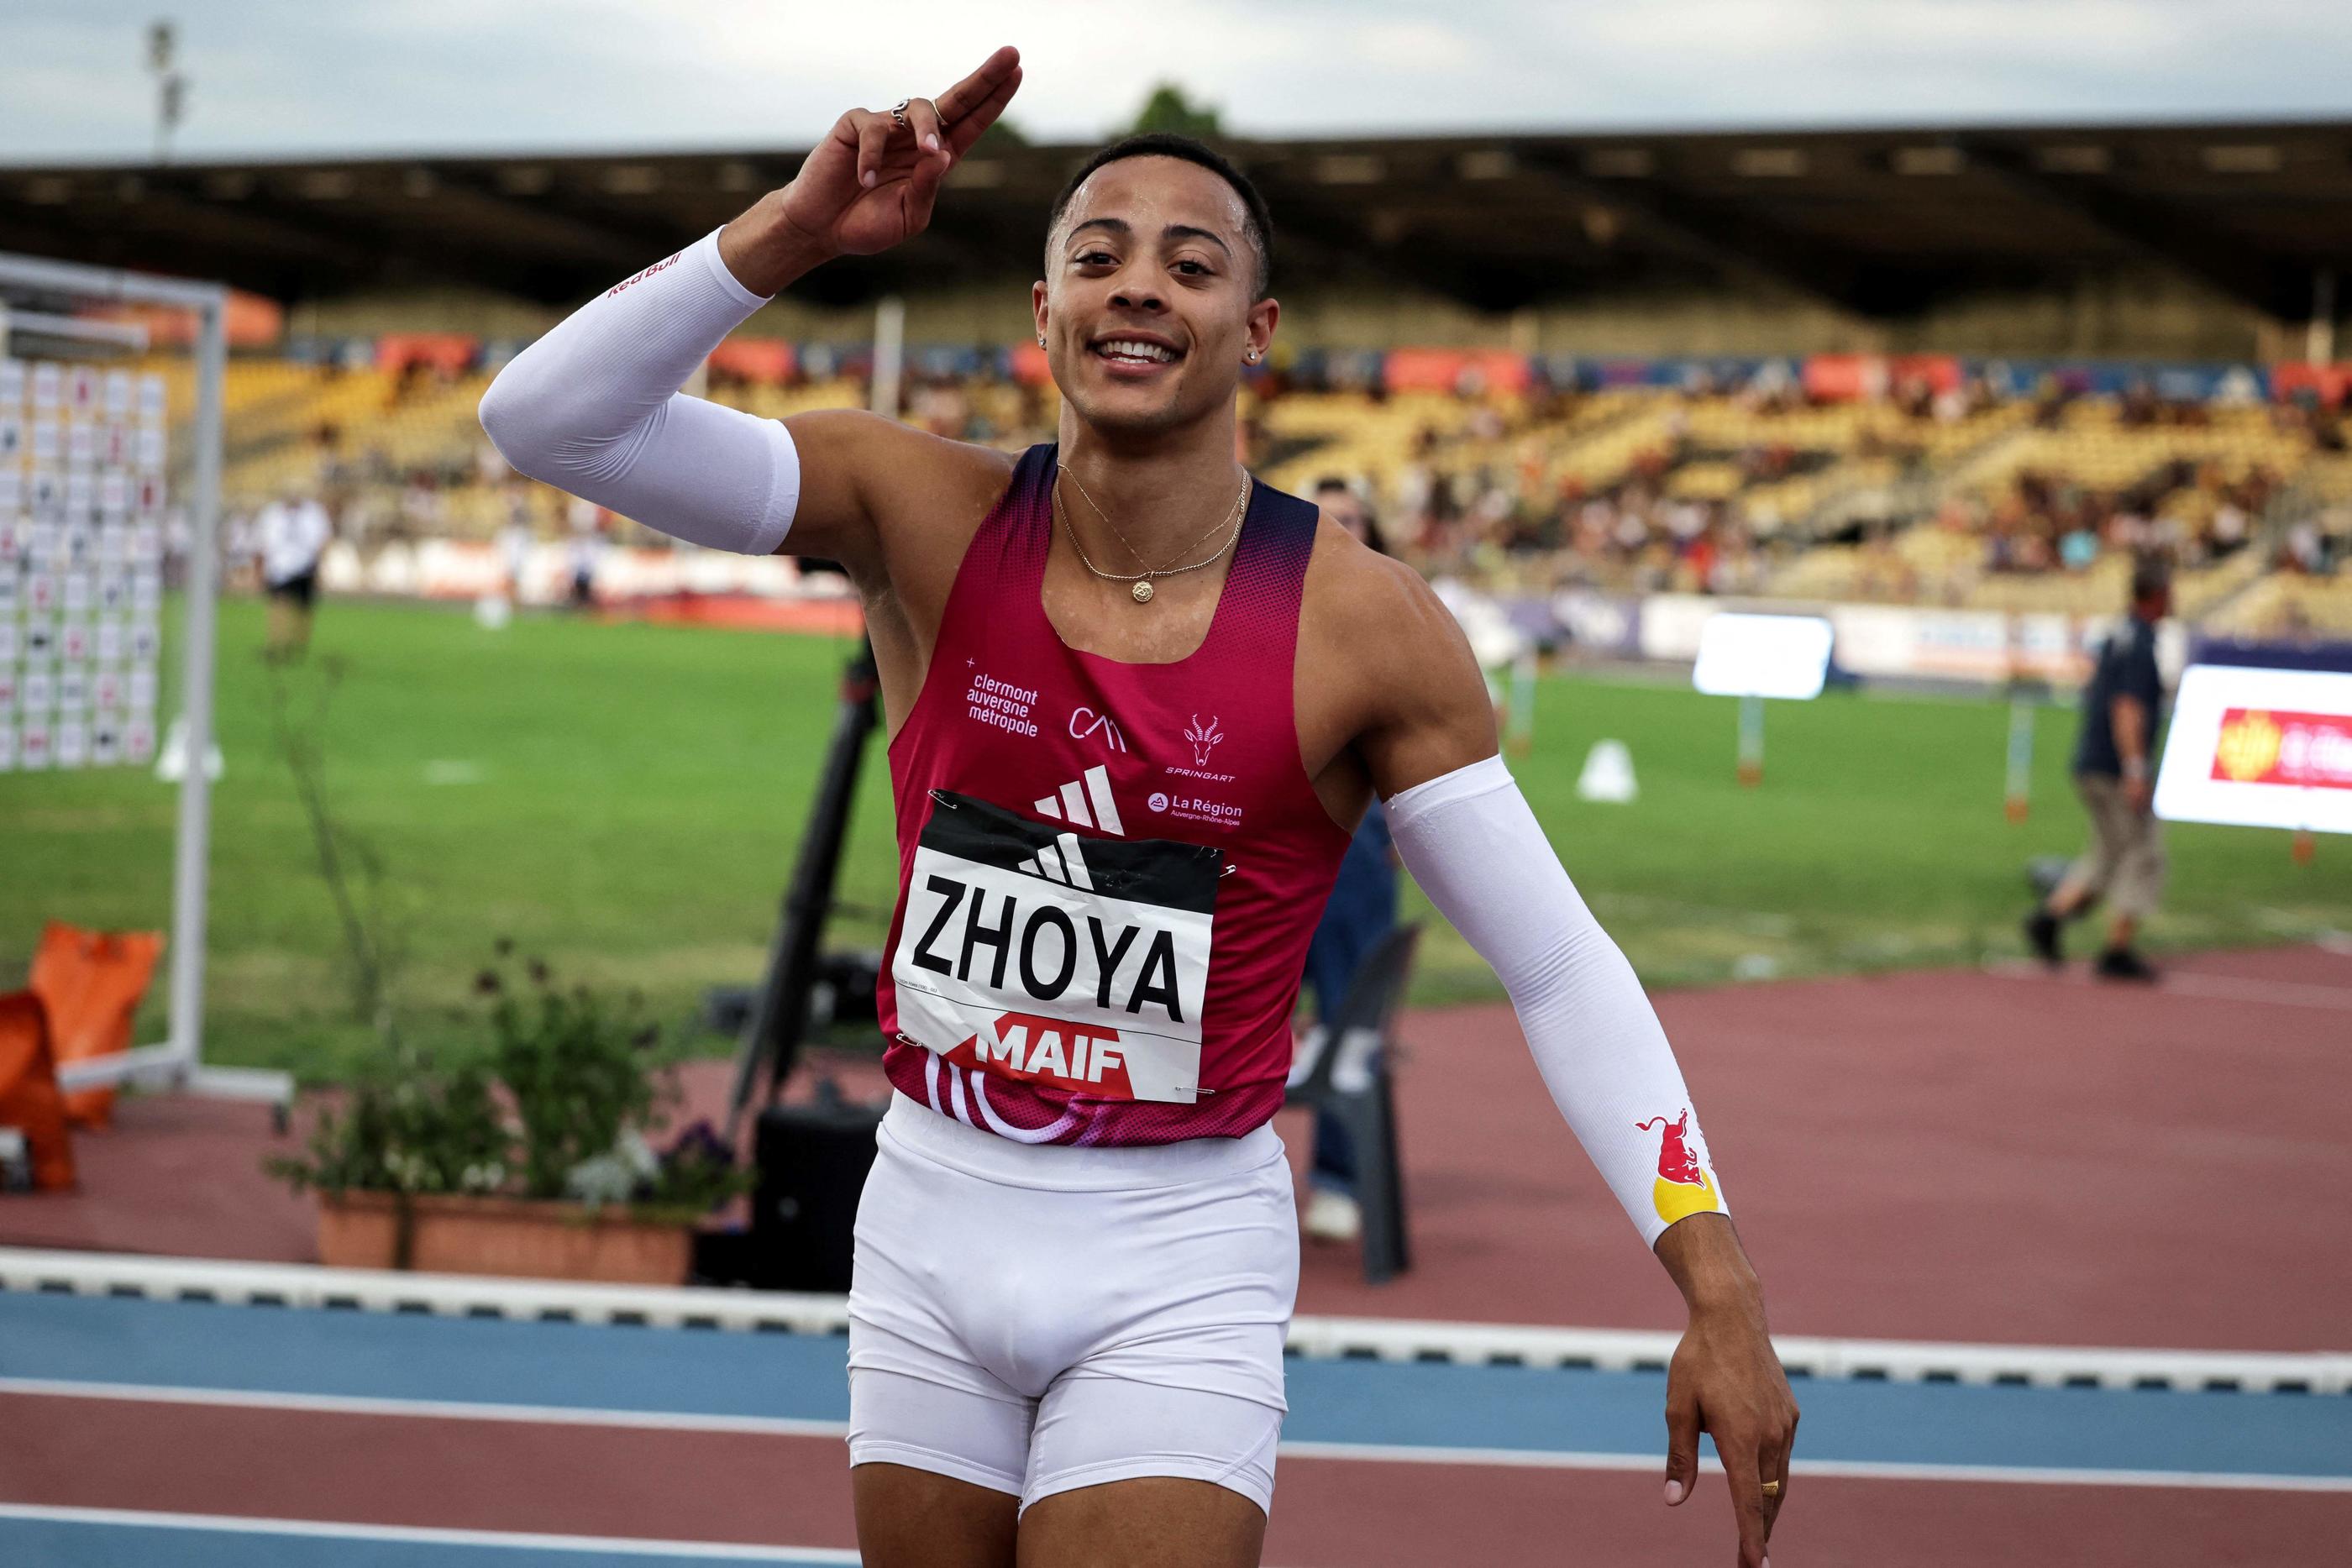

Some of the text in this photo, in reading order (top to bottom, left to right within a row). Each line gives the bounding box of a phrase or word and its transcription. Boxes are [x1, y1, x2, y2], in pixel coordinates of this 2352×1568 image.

[607, 252, 681, 298] Red Bull
[967, 689, 1029, 718] auvergne
[974, 674, 1038, 705] clermont
[969, 705, 1038, 737] métropole
[1165, 767, 1236, 783] SPRINGART
[1170, 810, 1240, 826] Auvergne-Rhône-Alpes
[1172, 795, 1242, 817] La Région
[911, 874, 1185, 1023] ZHOYA
[974, 1025, 1121, 1083] MAIF
